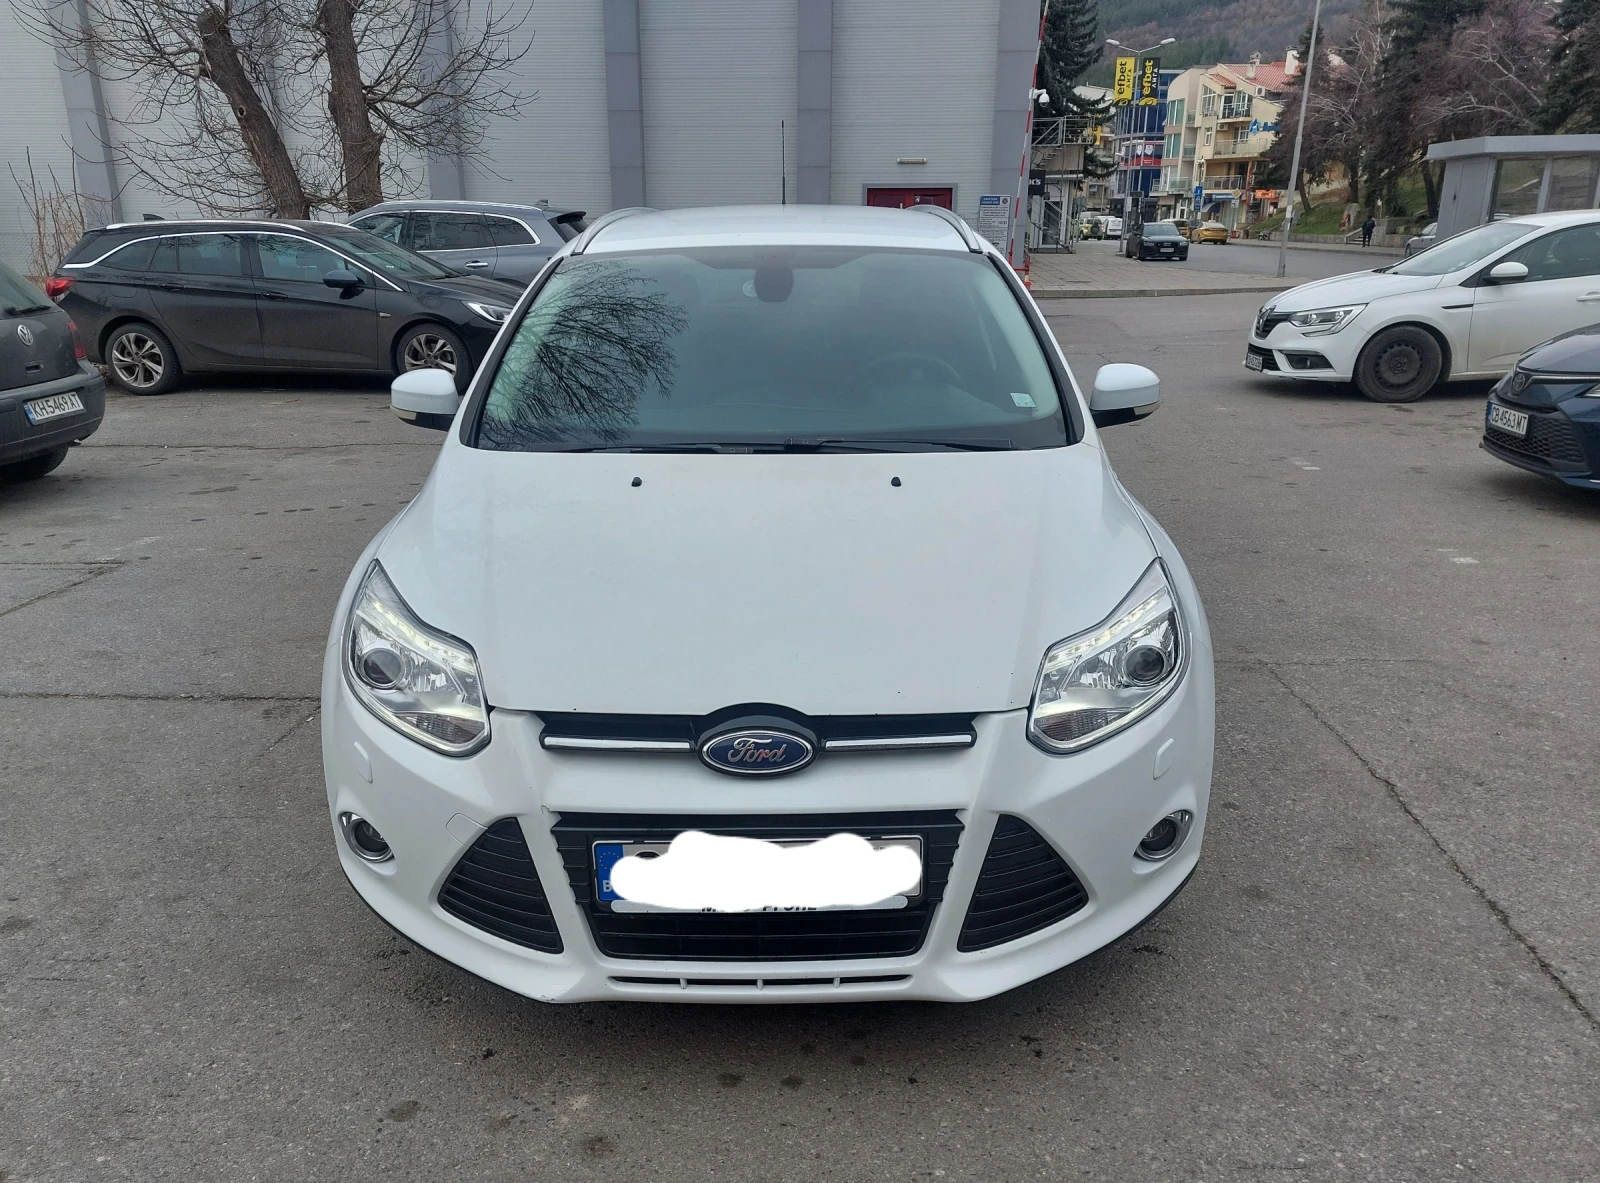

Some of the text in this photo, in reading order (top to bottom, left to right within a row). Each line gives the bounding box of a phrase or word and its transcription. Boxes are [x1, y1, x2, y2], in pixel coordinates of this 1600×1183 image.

[1117, 60, 1127, 95] efbet
[1142, 59, 1153, 95] efbet
[727, 737, 788, 762] Ford
